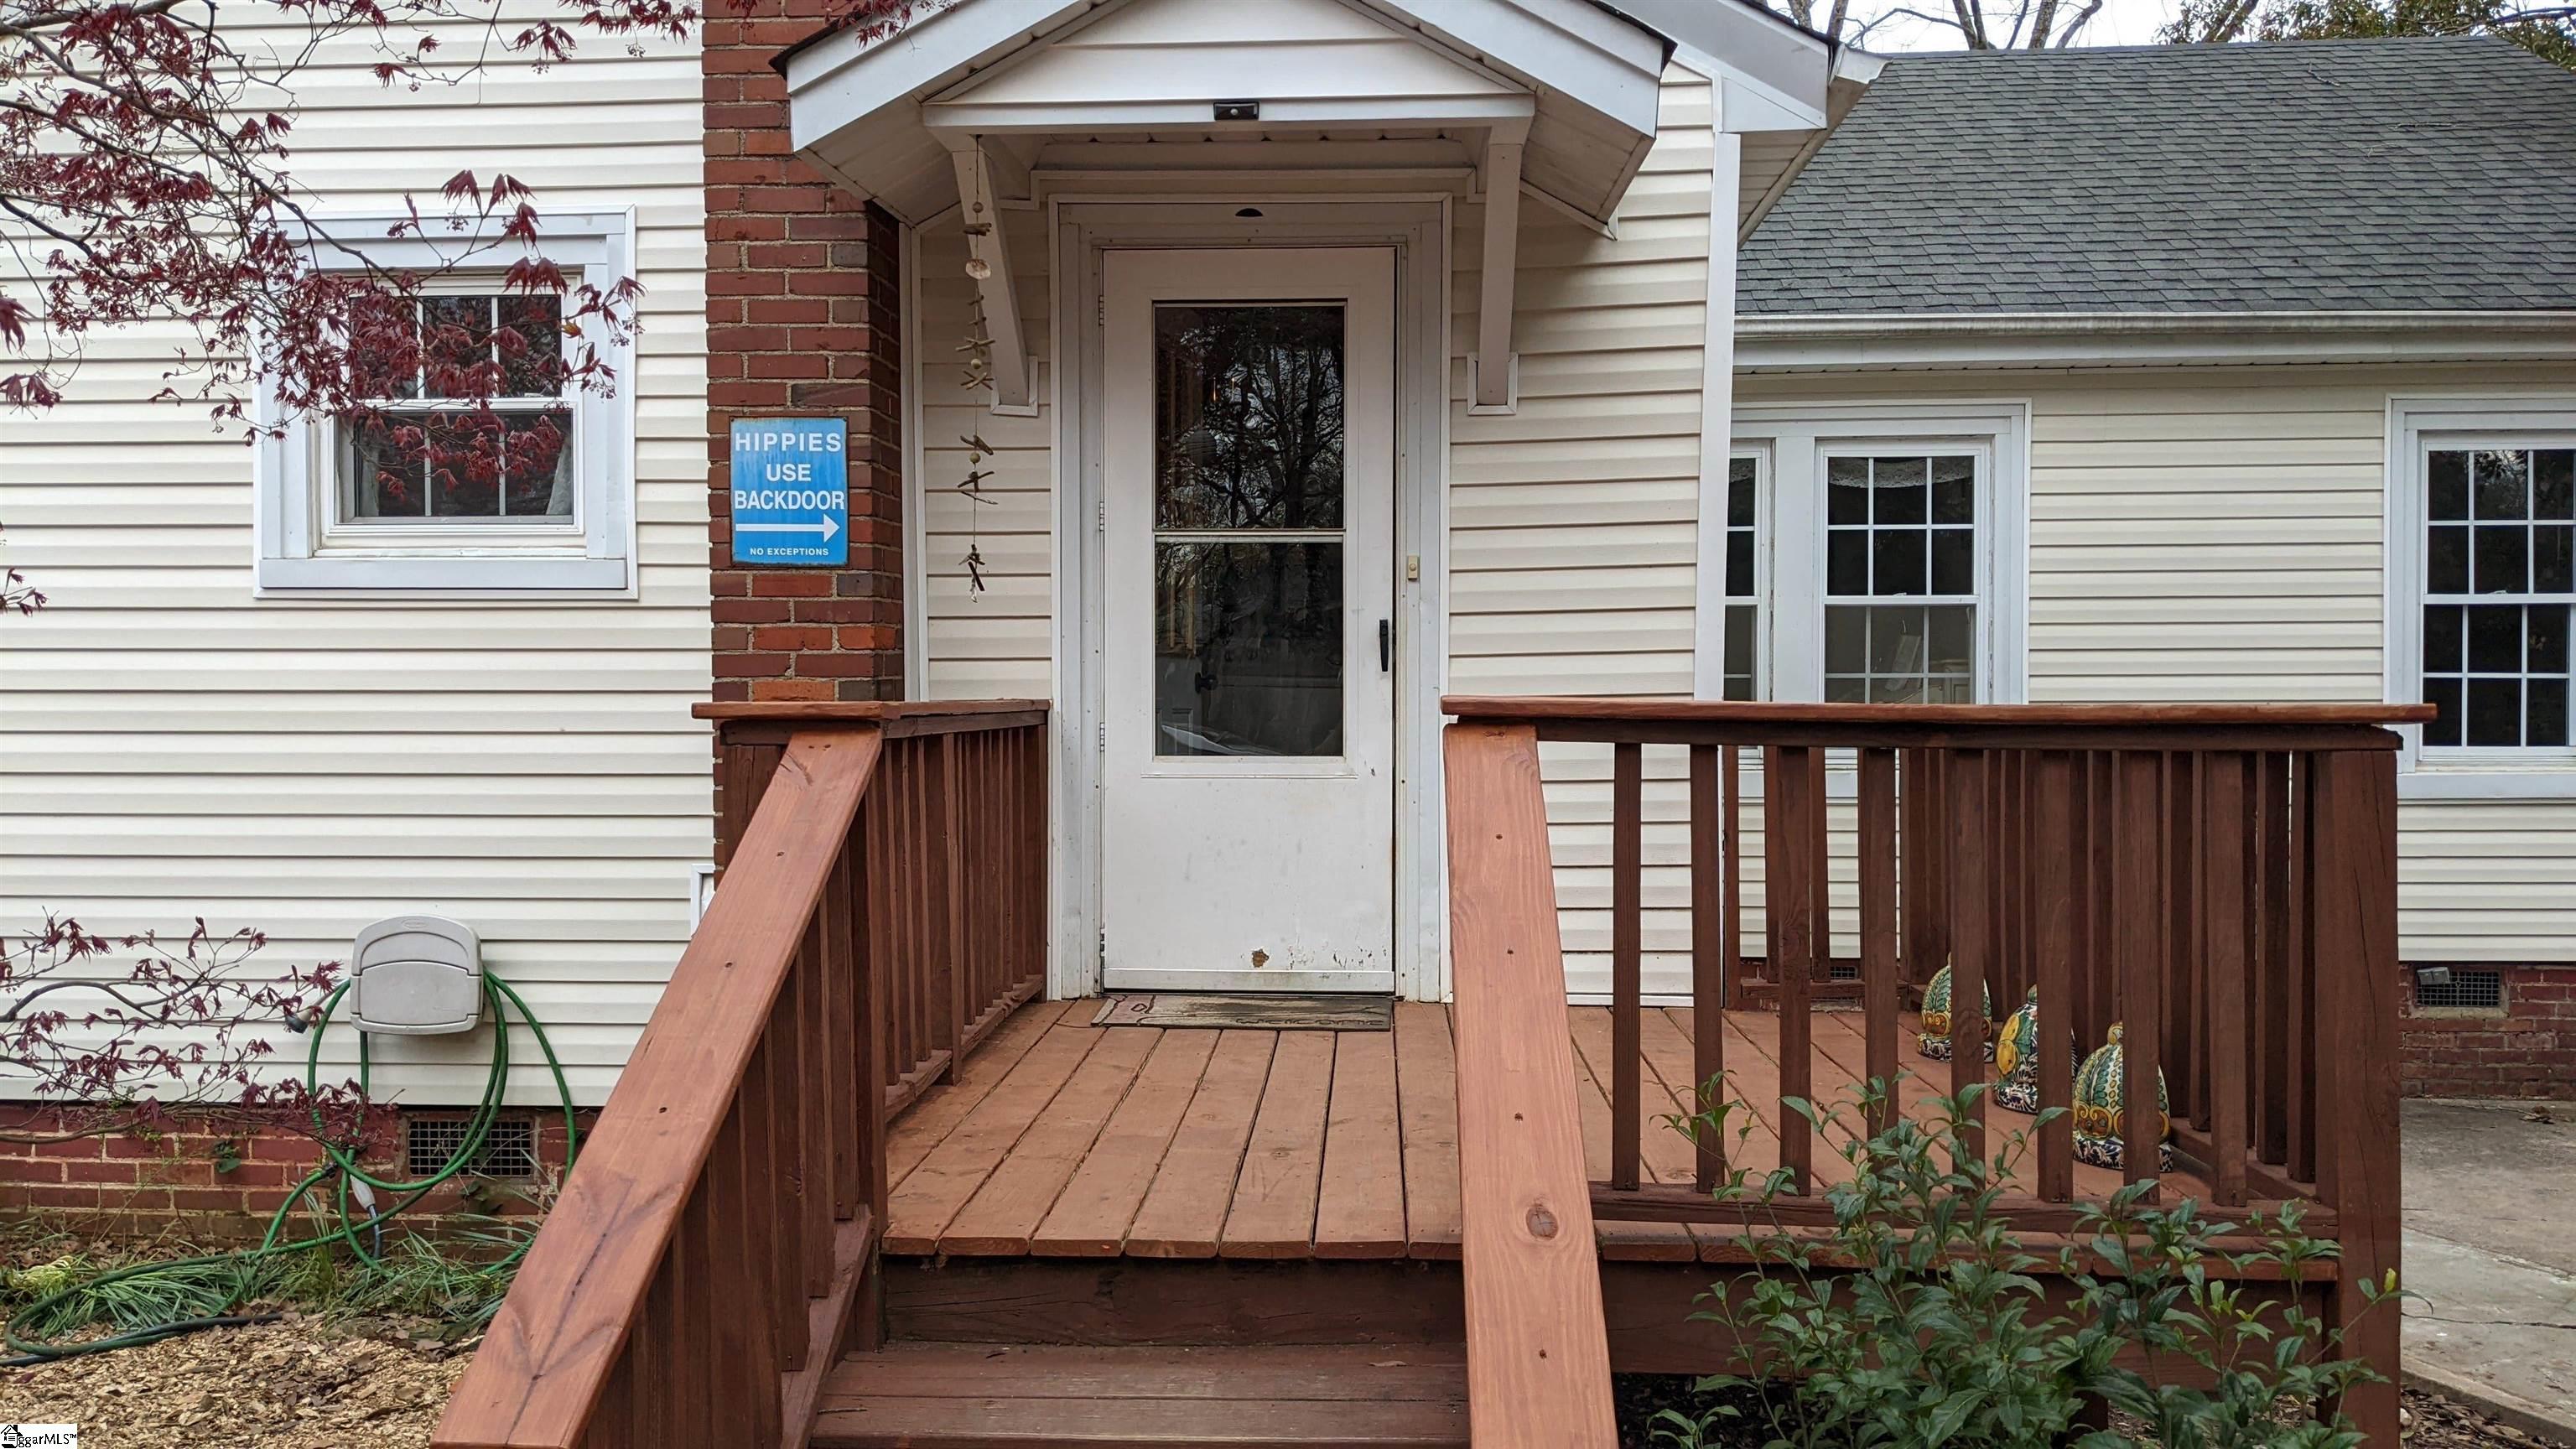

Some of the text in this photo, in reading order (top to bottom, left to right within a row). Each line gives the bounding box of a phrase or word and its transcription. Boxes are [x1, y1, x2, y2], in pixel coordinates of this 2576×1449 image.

[735, 433, 842, 452] HIPPIES
[766, 463, 812, 482] USE
[734, 491, 845, 510] BACKDOOR
[750, 548, 829, 556] NO EXCEPTIONS
